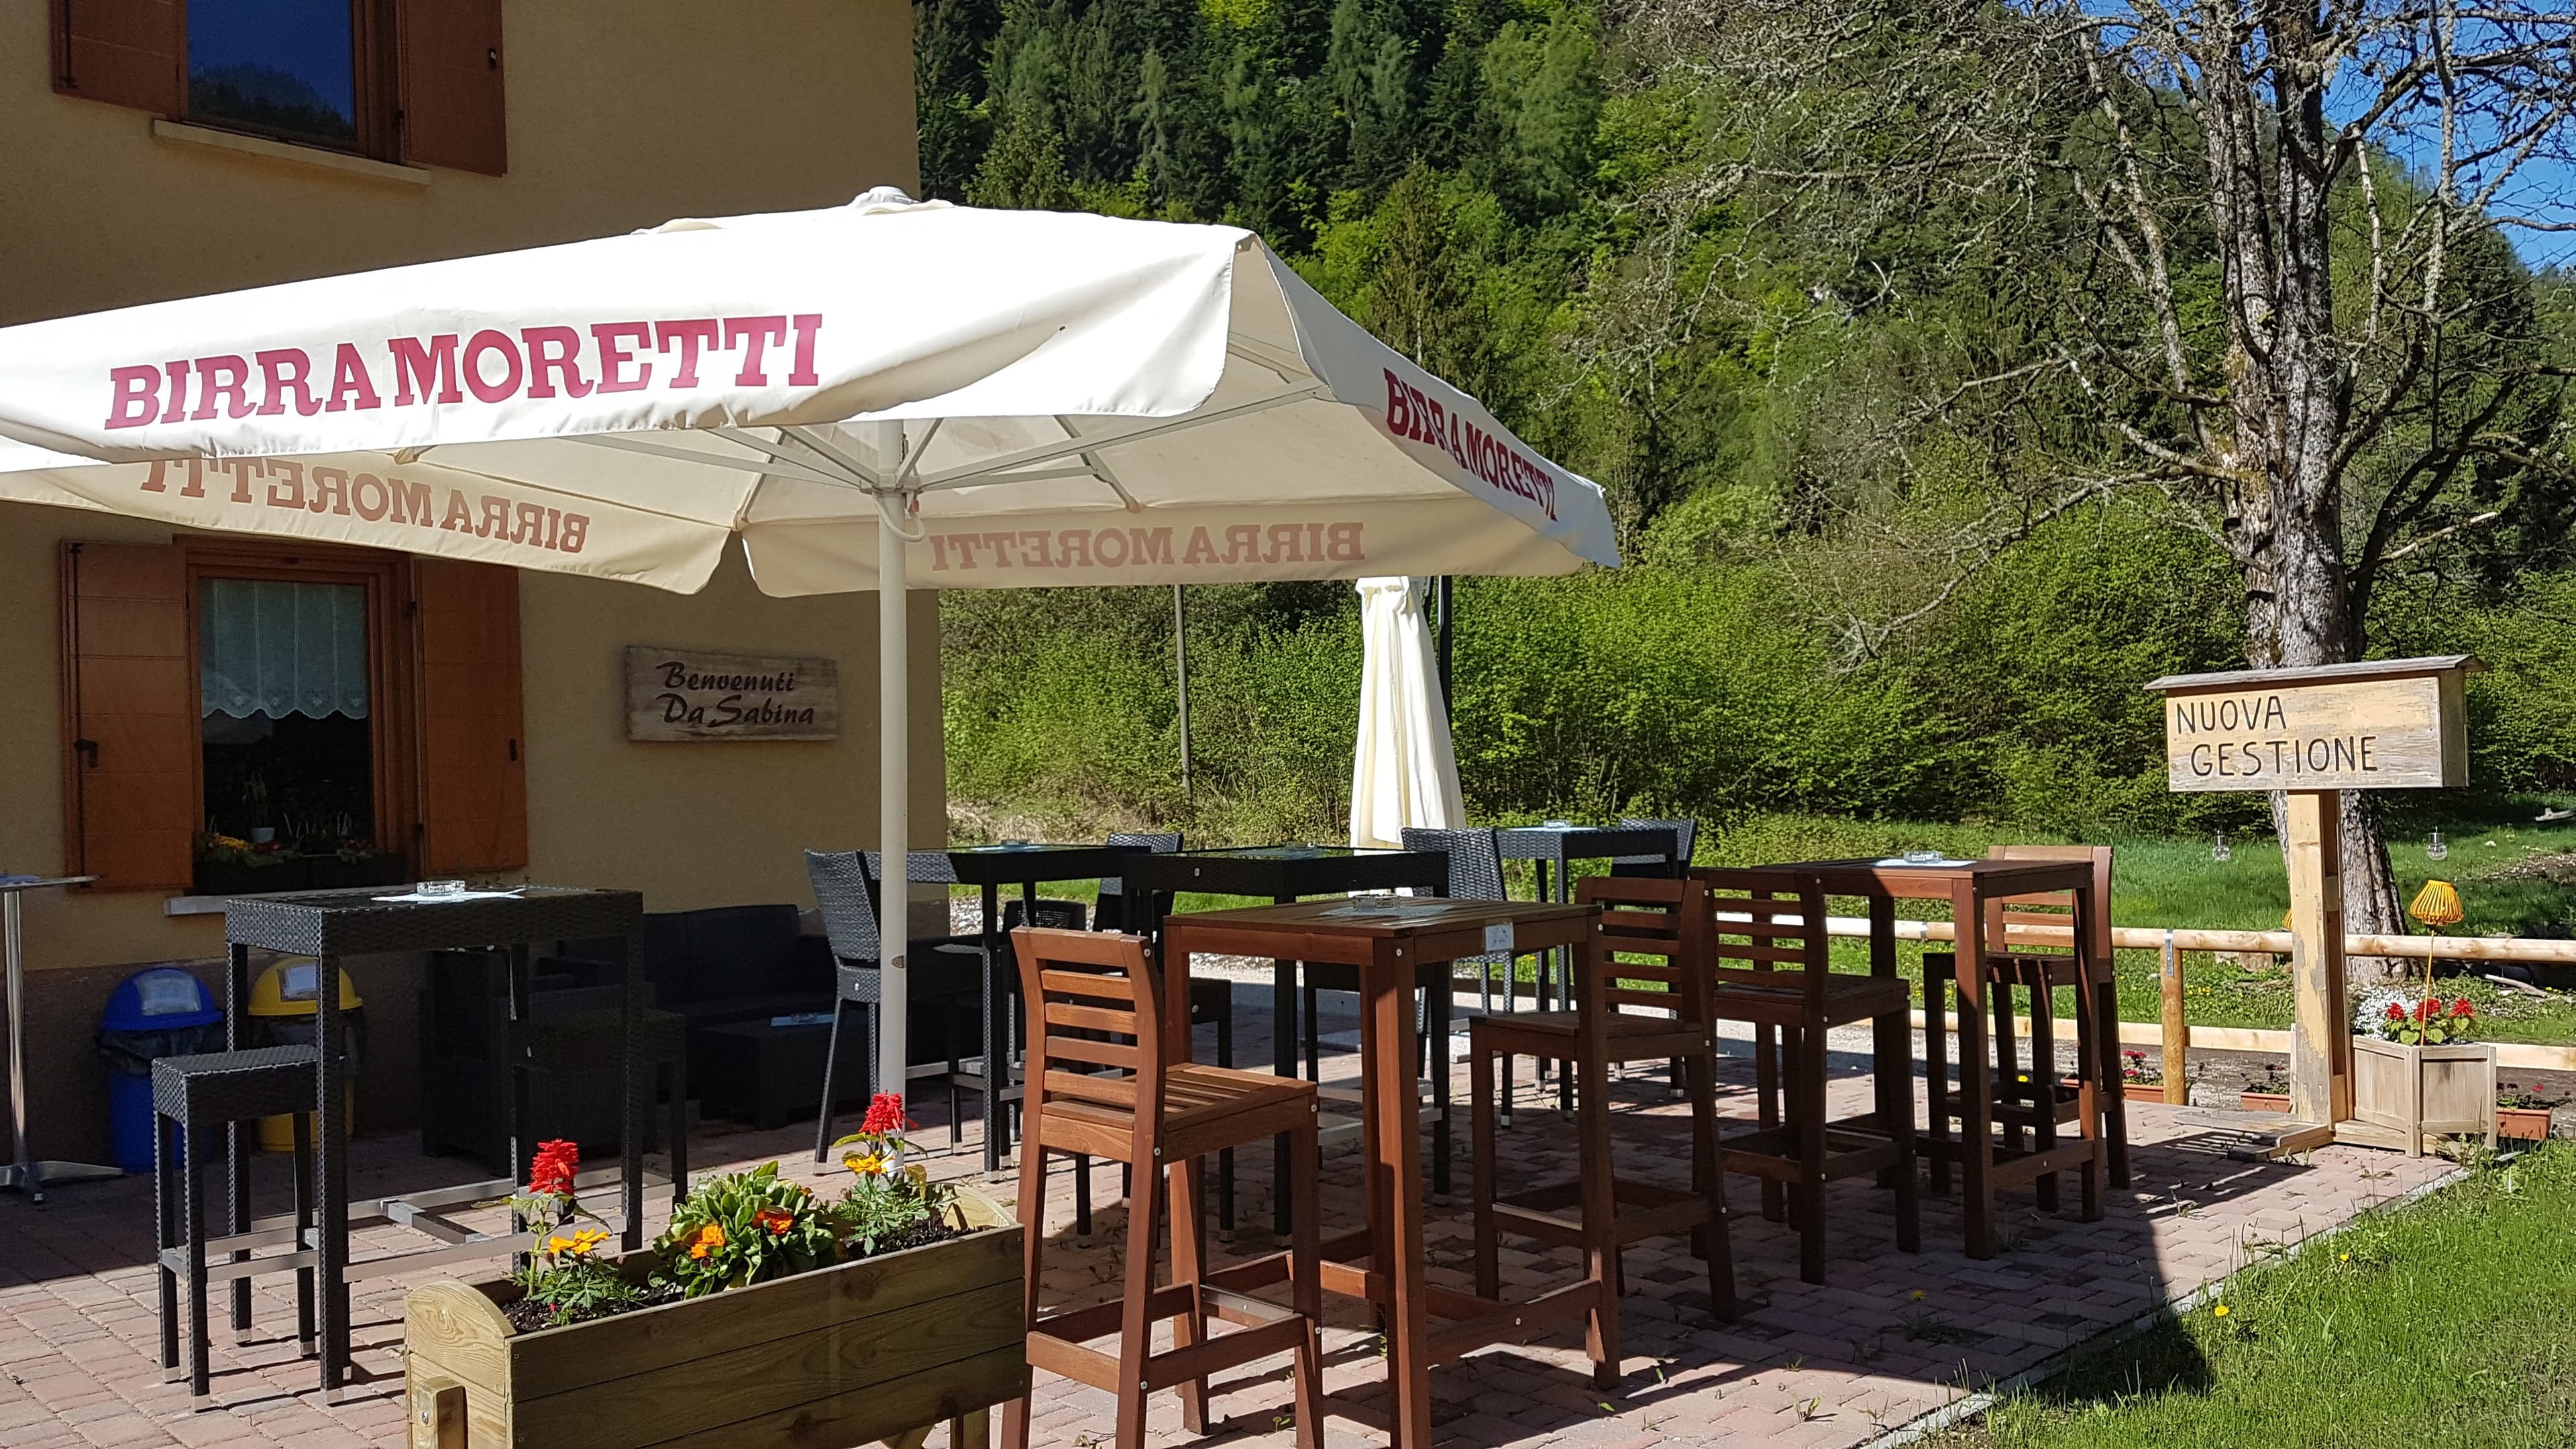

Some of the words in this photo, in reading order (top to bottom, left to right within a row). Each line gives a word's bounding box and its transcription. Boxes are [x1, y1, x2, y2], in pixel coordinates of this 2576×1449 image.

[105, 343, 381, 430] BIRRA
[388, 313, 822, 407] MORETTI
[1465, 420, 1558, 522] MORETTI
[655, 661, 795, 692] Benvenuti
[655, 692, 704, 724] Da
[707, 694, 814, 728] Sabina
[2176, 695, 2287, 735] NUOVA
[2190, 736, 2378, 777] GESTIONE
